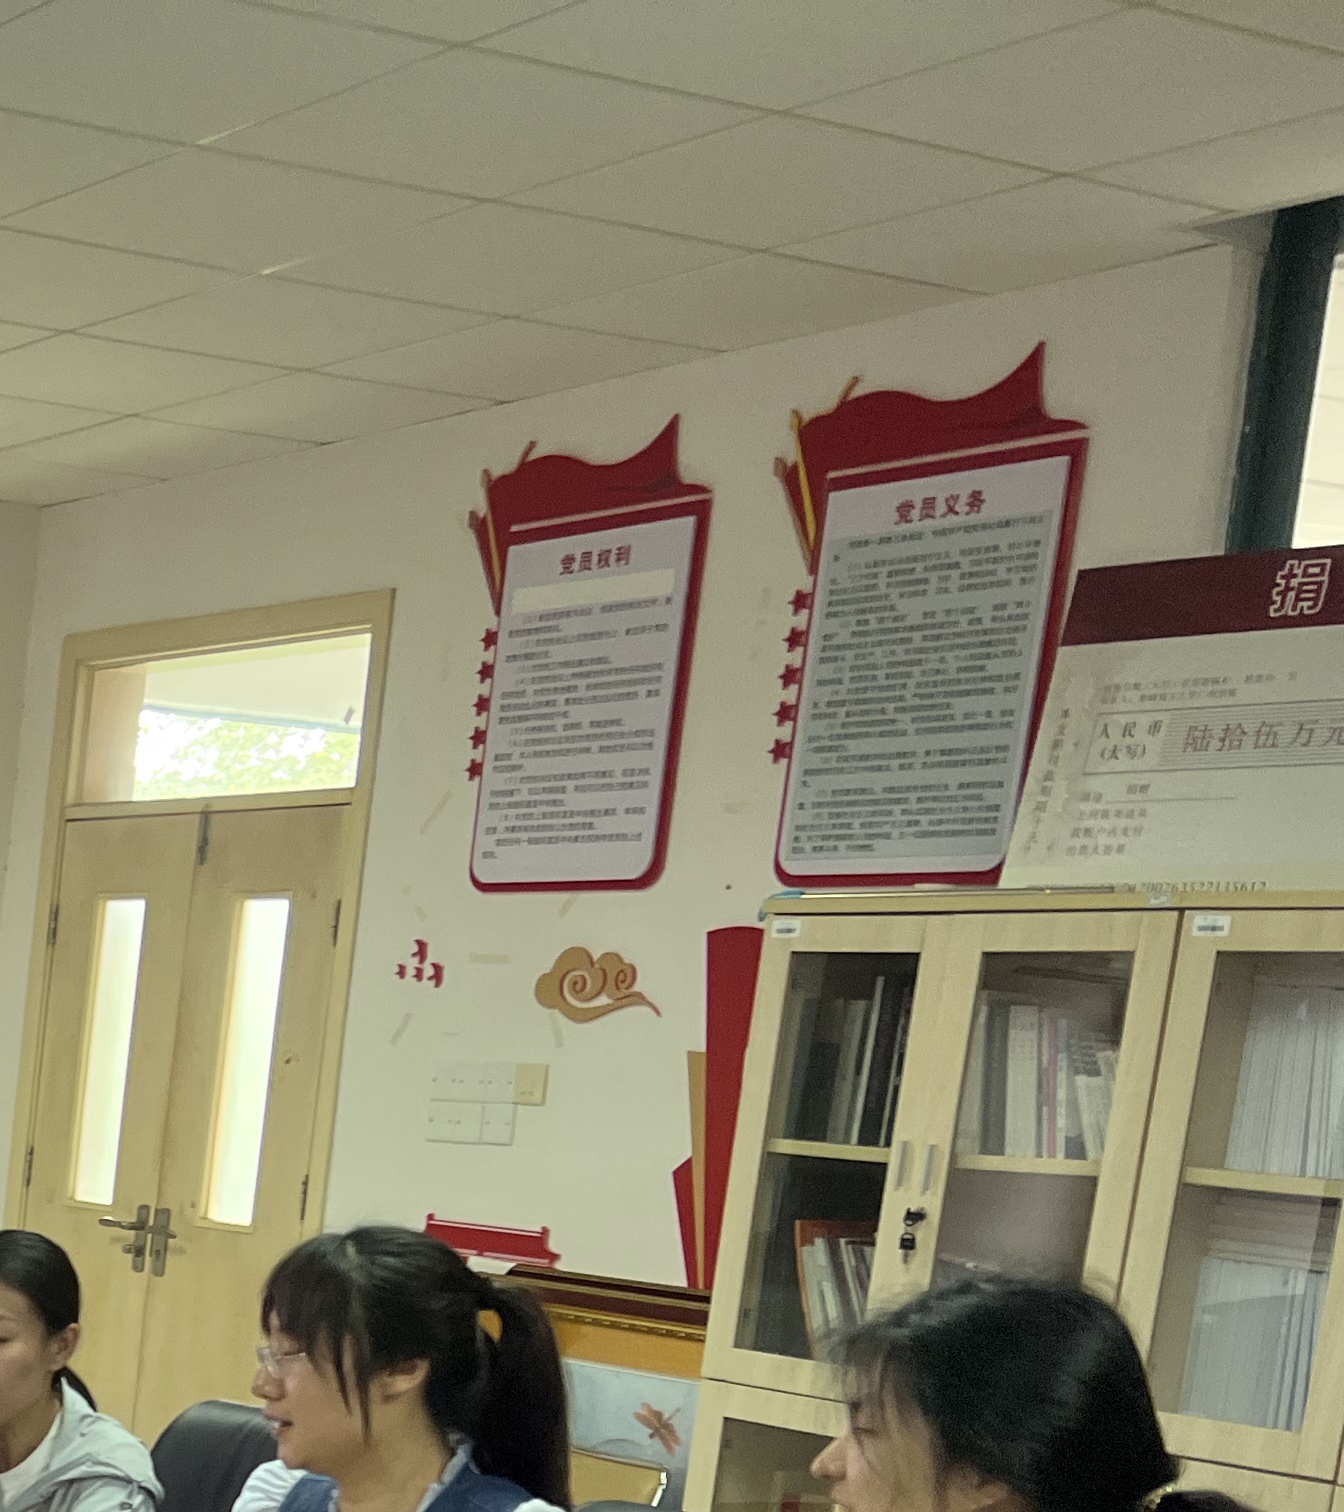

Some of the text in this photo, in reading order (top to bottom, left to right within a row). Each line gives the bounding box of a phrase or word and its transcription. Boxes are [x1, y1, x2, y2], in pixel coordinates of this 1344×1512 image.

[893, 489, 987, 526] 党员义务
[559, 544, 632, 577] 党员权利
[1268, 558, 1332, 618] 捐
